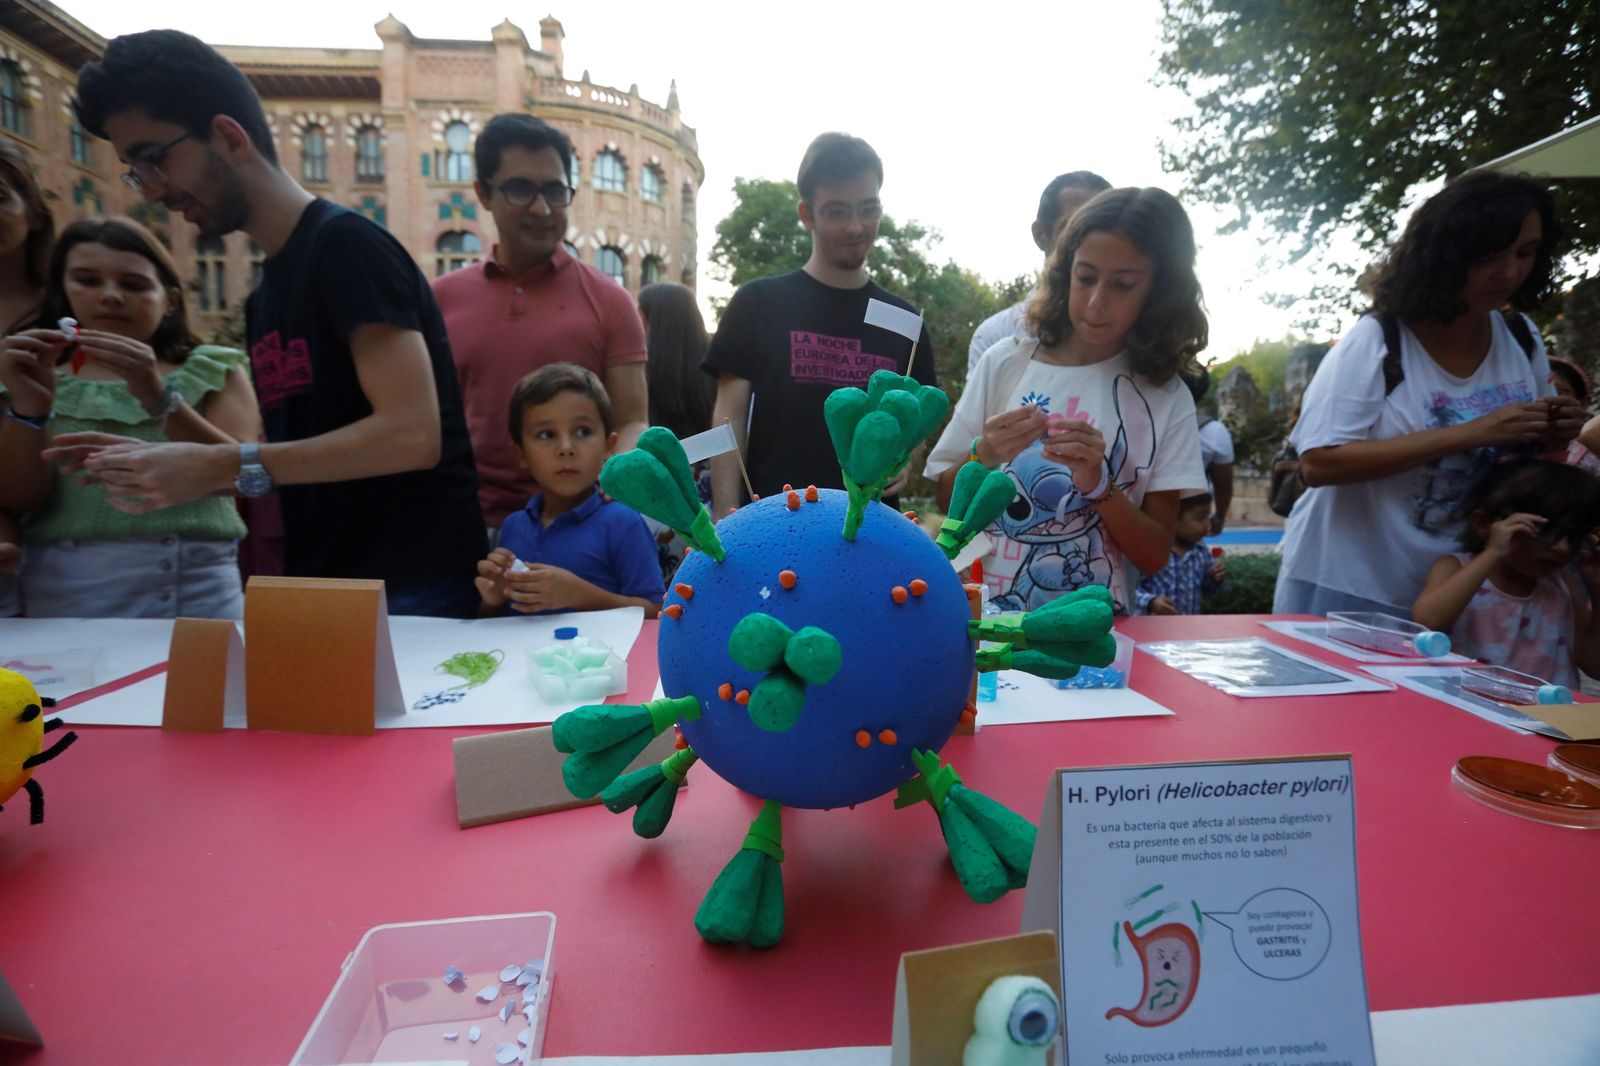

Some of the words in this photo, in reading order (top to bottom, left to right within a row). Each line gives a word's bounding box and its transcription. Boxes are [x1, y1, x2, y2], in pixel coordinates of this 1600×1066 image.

[794, 333, 811, 344] LA
[816, 336, 858, 352] NOCHE
[795, 348, 850, 365] EUROPEA
[855, 355, 871, 366] DE
[1068, 786, 1089, 804] H.
[1095, 784, 1150, 806] Pylori
[1157, 779, 1288, 804] (Helicobacter
[1289, 775, 1350, 798] pylori)
[1086, 823, 1099, 834] Es
[1101, 823, 1121, 833] una
[1124, 820, 1167, 832] bacteria
[1169, 820, 1190, 831] que
[1192, 817, 1224, 829] afecta
[1226, 816, 1236, 827] al
[1238, 815, 1277, 827] sistema
[1279, 813, 1324, 827] digestivo
[1325, 814, 1333, 824] y
[1108, 839, 1131, 850] esta
[1133, 837, 1180, 850] presente
[1182, 836, 1196, 846] en
[1198, 834, 1208, 846] el
[1210, 833, 1233, 845] 50%
[1235, 832, 1248, 843] de
[1251, 832, 1260, 843] la
[1262, 830, 1312, 844] población
[1135, 853, 1179, 866] (aunque
[1181, 849, 1223, 861] muchos
[1225, 850, 1239, 860] no
[1241, 848, 1252, 859] lo
[1254, 846, 1288, 859] saben)
[1256, 935, 1300, 946] GASTRITIS
[1263, 948, 1302, 959] ULCERAS
[1104, 1053, 1129, 1065] Solo
[1131, 1051, 1175, 1065] provoca
[1177, 1045, 1243, 1060] enfermedad
[1245, 1046, 1260, 1057] en
[1262, 1045, 1277, 1056] un
[1279, 1041, 1328, 1056] pequeño
